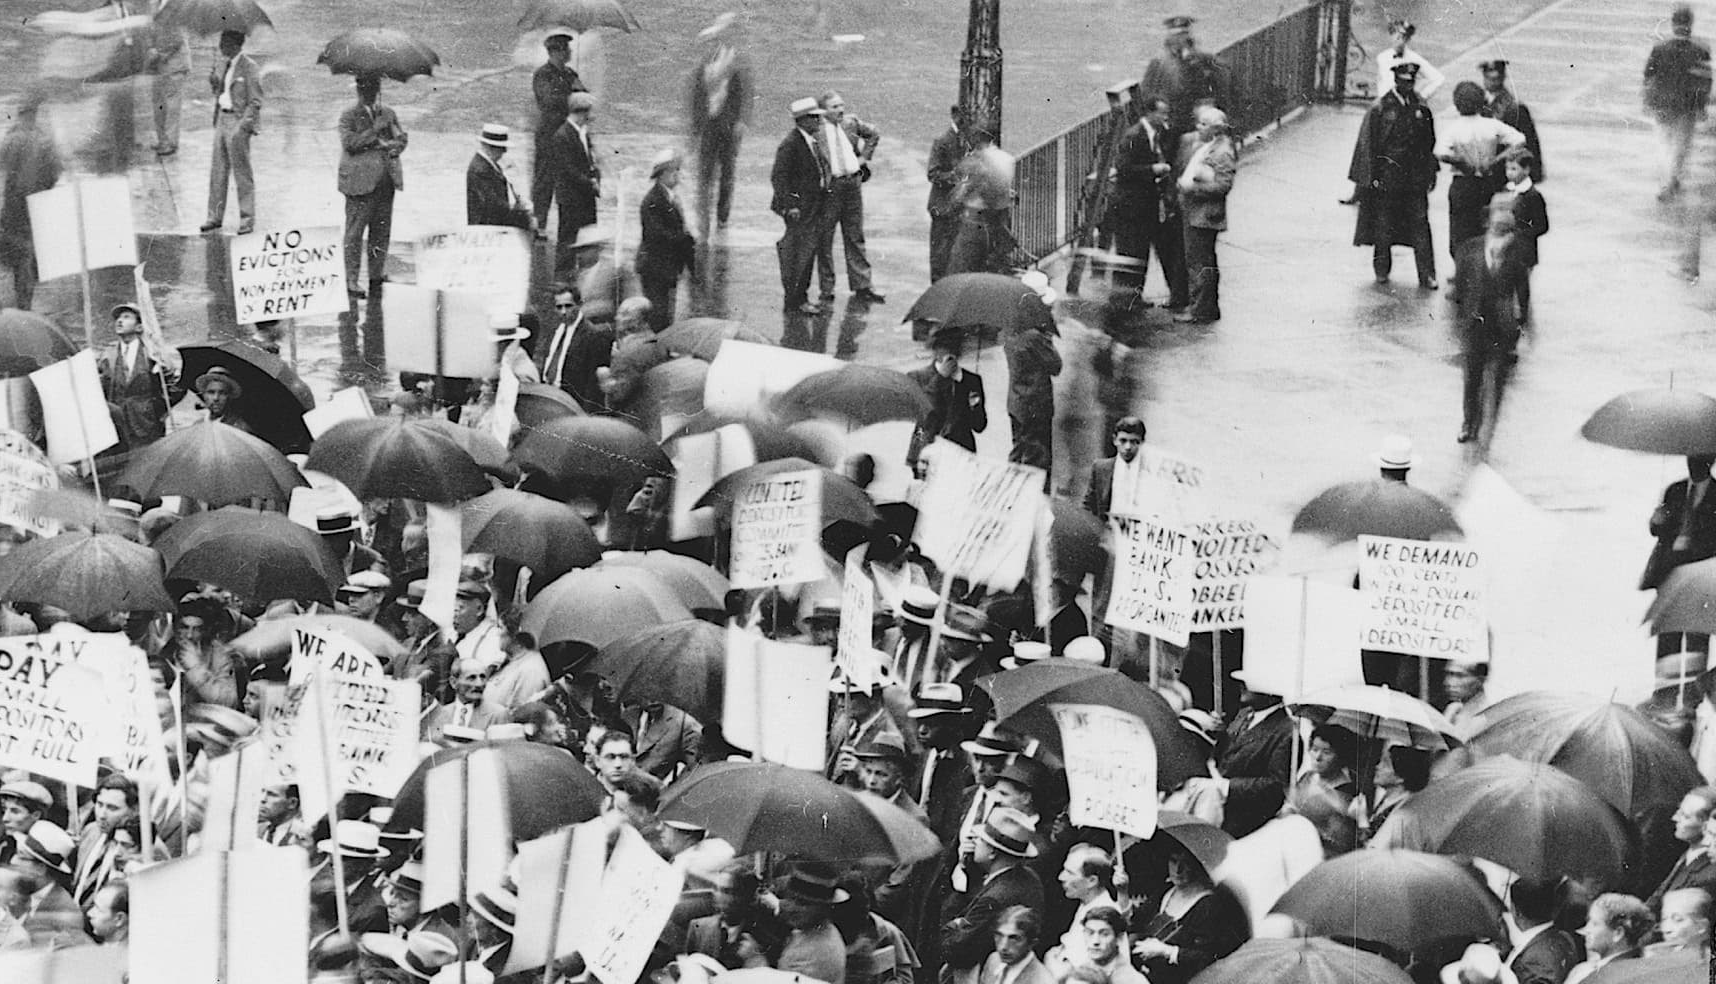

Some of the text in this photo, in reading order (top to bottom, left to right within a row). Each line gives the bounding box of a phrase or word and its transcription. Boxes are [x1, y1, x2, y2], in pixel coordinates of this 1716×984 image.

[262, 229, 302, 252] NO
[238, 244, 337, 271] EVICTIONS
[263, 293, 314, 315] RENT
[1110, 516, 1188, 557] WE WANT
[1191, 533, 1266, 558] LOITED
[1130, 546, 1173, 580] BANK
[1366, 542, 1480, 569] WE DEMAND
[1195, 558, 1256, 581] OSSES
[1414, 568, 1459, 585] CENTS
[1428, 586, 1480, 602] DOLLAR
[1371, 596, 1466, 620] DEPOSITED
[1384, 616, 1445, 633] SMALL
[295, 628, 327, 657] WE
[32, 739, 77, 764] FULL
